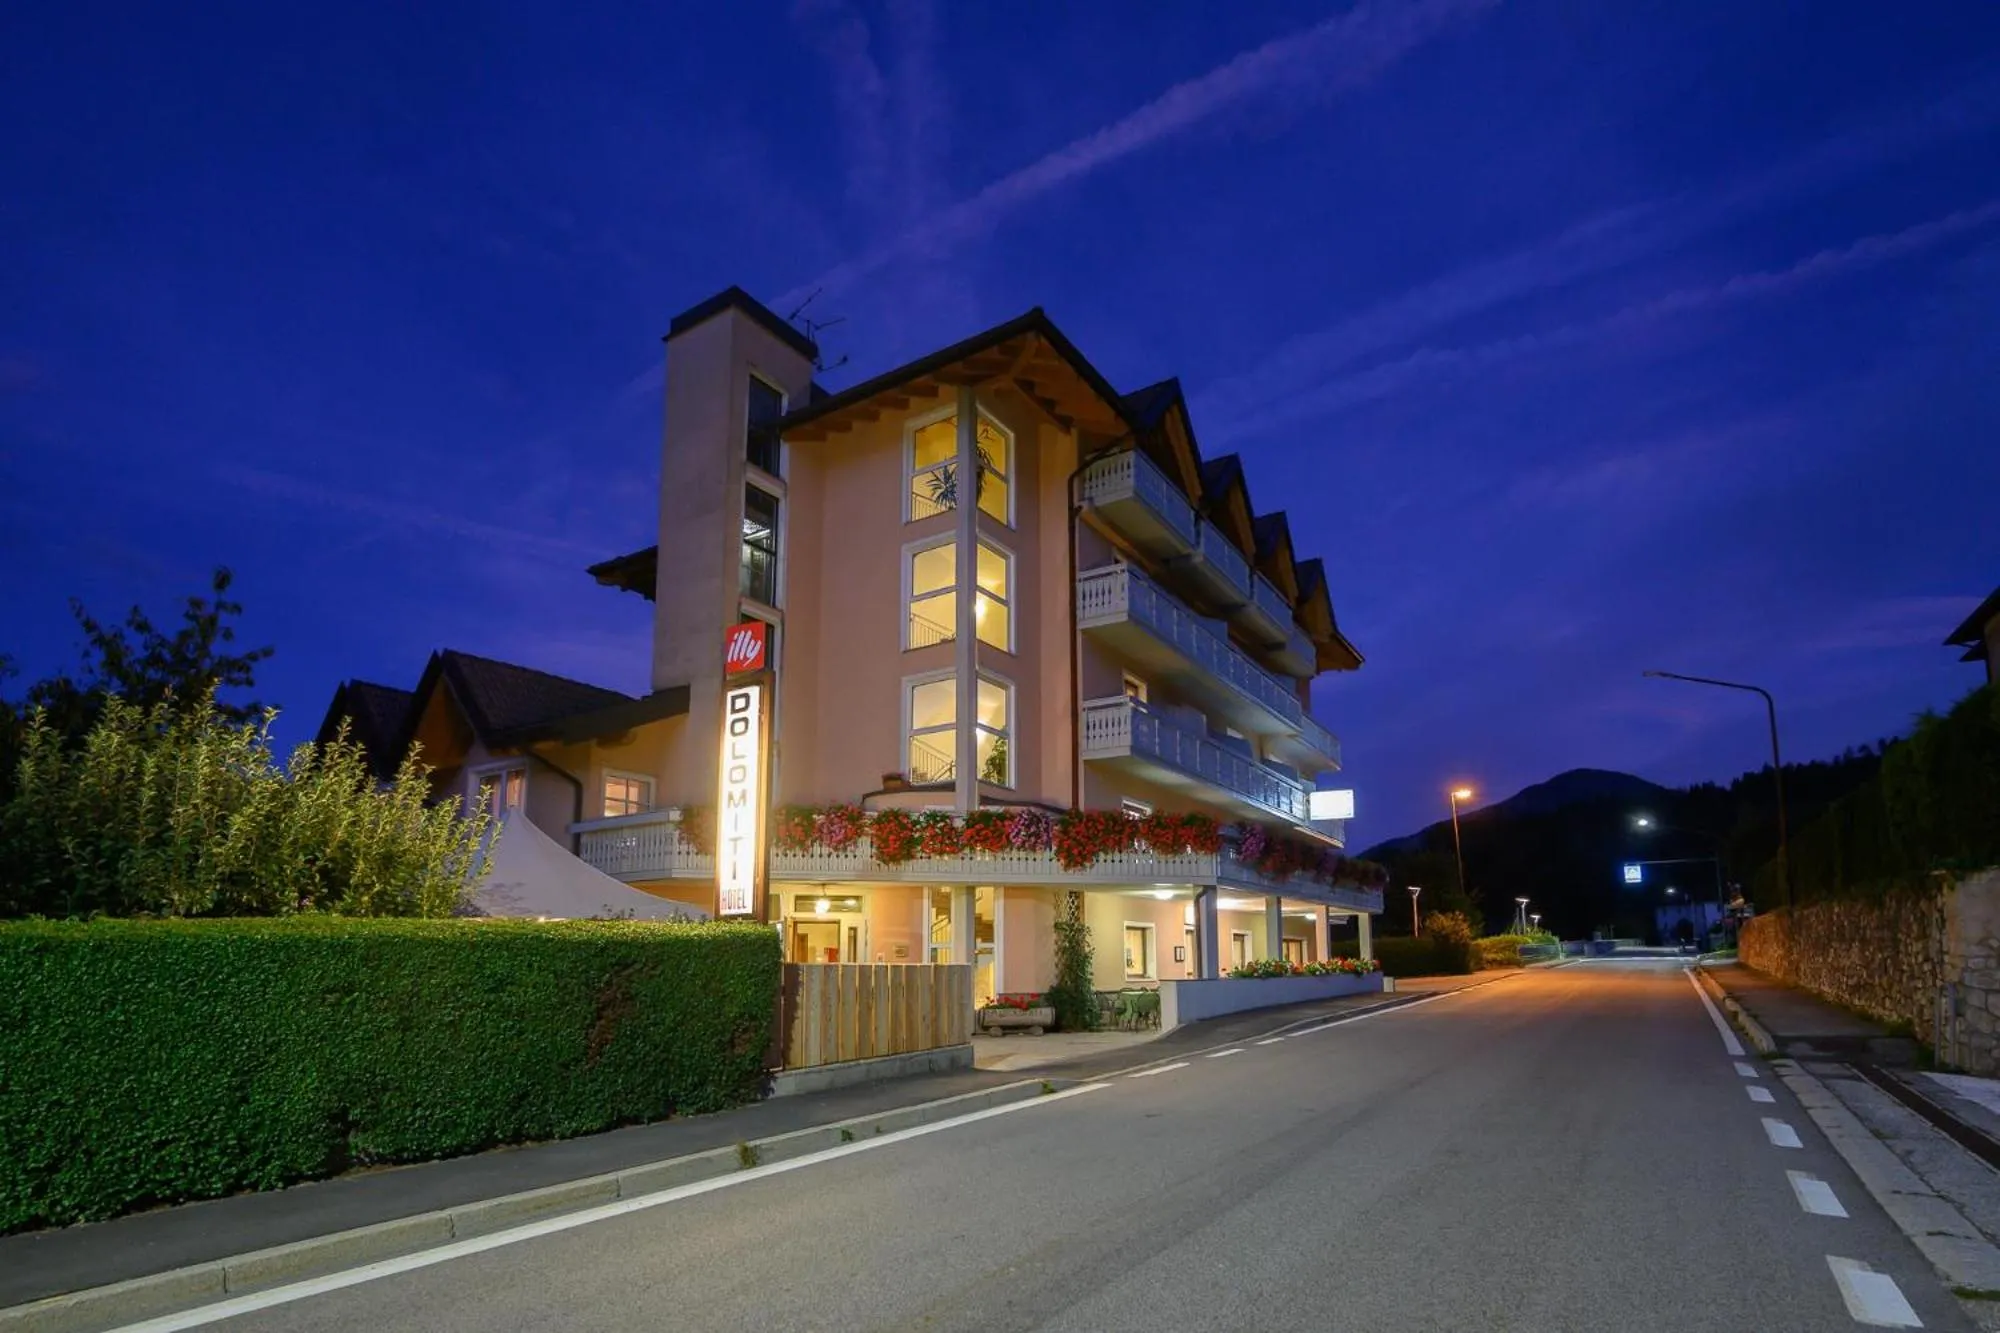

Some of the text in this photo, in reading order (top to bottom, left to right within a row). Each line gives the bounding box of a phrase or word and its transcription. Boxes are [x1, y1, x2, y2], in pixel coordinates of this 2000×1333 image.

[727, 630, 762, 668] illy
[727, 692, 751, 881] DOLOMITI
[720, 888, 748, 910] HOTEL
